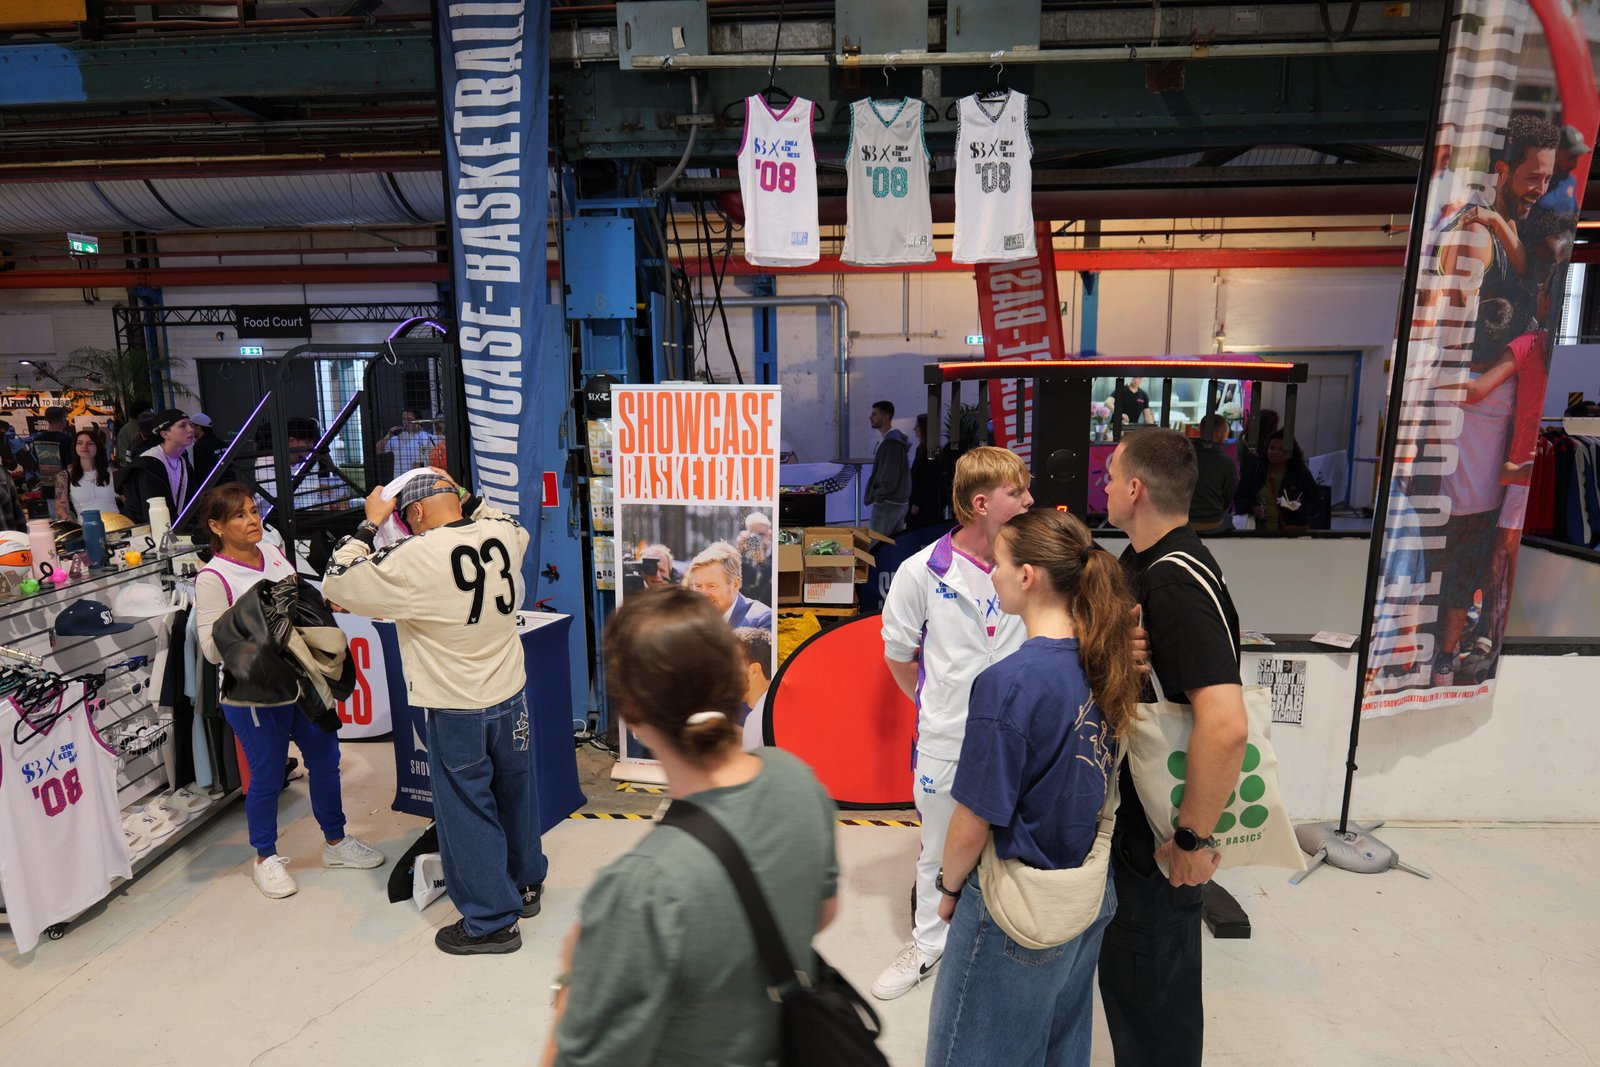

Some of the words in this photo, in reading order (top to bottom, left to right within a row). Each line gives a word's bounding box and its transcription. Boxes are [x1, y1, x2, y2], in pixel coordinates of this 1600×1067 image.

[879, 144, 891, 163] X
[988, 138, 998, 157] X
[449, 0, 525, 516] HOWCASE-BASKETBALL
[243, 317, 270, 328] Food
[272, 316, 304, 327] Court
[1394, 222, 1492, 477] CONNECT
[2, 396, 40, 408] AFRICA
[618, 391, 775, 456] SHOWCASE
[619, 456, 774, 501] BASKETBALL
[1380, 494, 1452, 562] TO
[450, 537, 516, 626] 93
[1259, 659, 1283, 673] SCAN
[1275, 673, 1295, 684] WAIT
[1296, 673, 1305, 684] IN
[1273, 684, 1289, 695] FOR
[1290, 684, 1304, 695] THE
[1272, 710, 1302, 722] ACHINE
[46, 748, 59, 775] X
[58, 750, 73, 760] KER
[410, 760, 430, 777] SHO
[1226, 831, 1262, 846] BASICS
